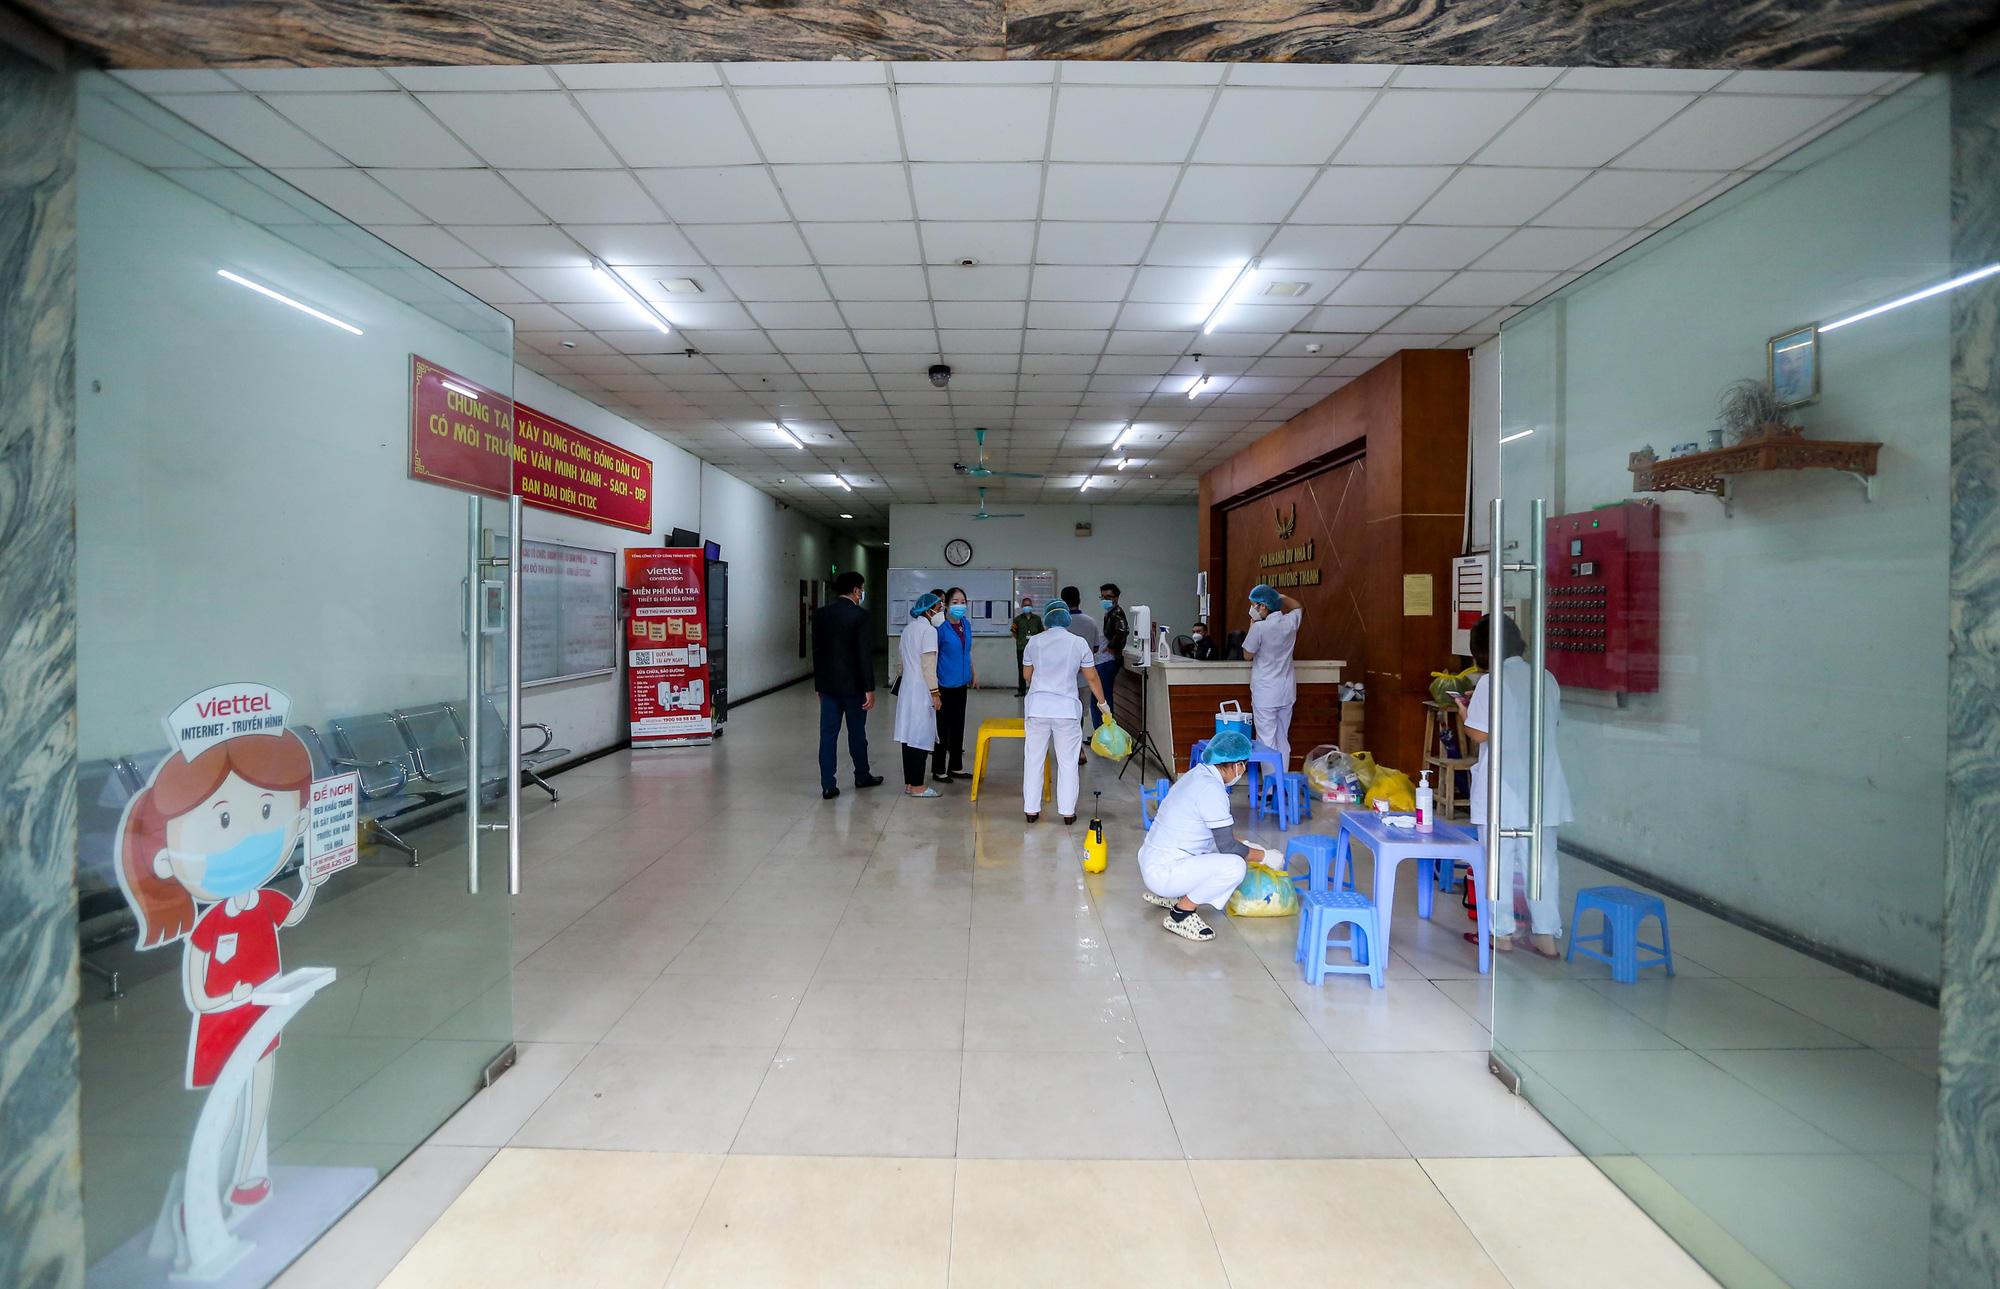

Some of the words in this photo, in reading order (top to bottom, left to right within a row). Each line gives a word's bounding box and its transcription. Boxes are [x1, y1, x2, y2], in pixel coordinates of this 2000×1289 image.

[494, 408, 512, 432] TA
[518, 419, 539, 442] XÂY
[542, 429, 567, 453] DỰNG
[570, 440, 591, 462] CỘNG
[616, 459, 630, 477] DÂN
[631, 466, 640, 480] CƯ
[429, 413, 448, 437] CÓ
[453, 423, 480, 448] MÔI
[530, 450, 552, 472] VĂN
[554, 459, 577, 480] MINH
[580, 467, 602, 488] XANH
[609, 478, 628, 497] SẠCH
[634, 487, 647, 503] ĐẸP
[522, 476, 541, 495] BAN
[543, 482, 558, 501] ĐẠI
[560, 487, 576, 505] DIỆN
[578, 492, 597, 510] CT12C
[646, 567, 683, 575] viettel
[652, 587, 665, 595] PHÍ
[196, 693, 271, 718] viettel
[181, 723, 224, 741] INTERNET
[264, 714, 283, 728] HÌNH
[313, 785, 328, 802] ĐỀ
[329, 783, 353, 798] NGHỊ
